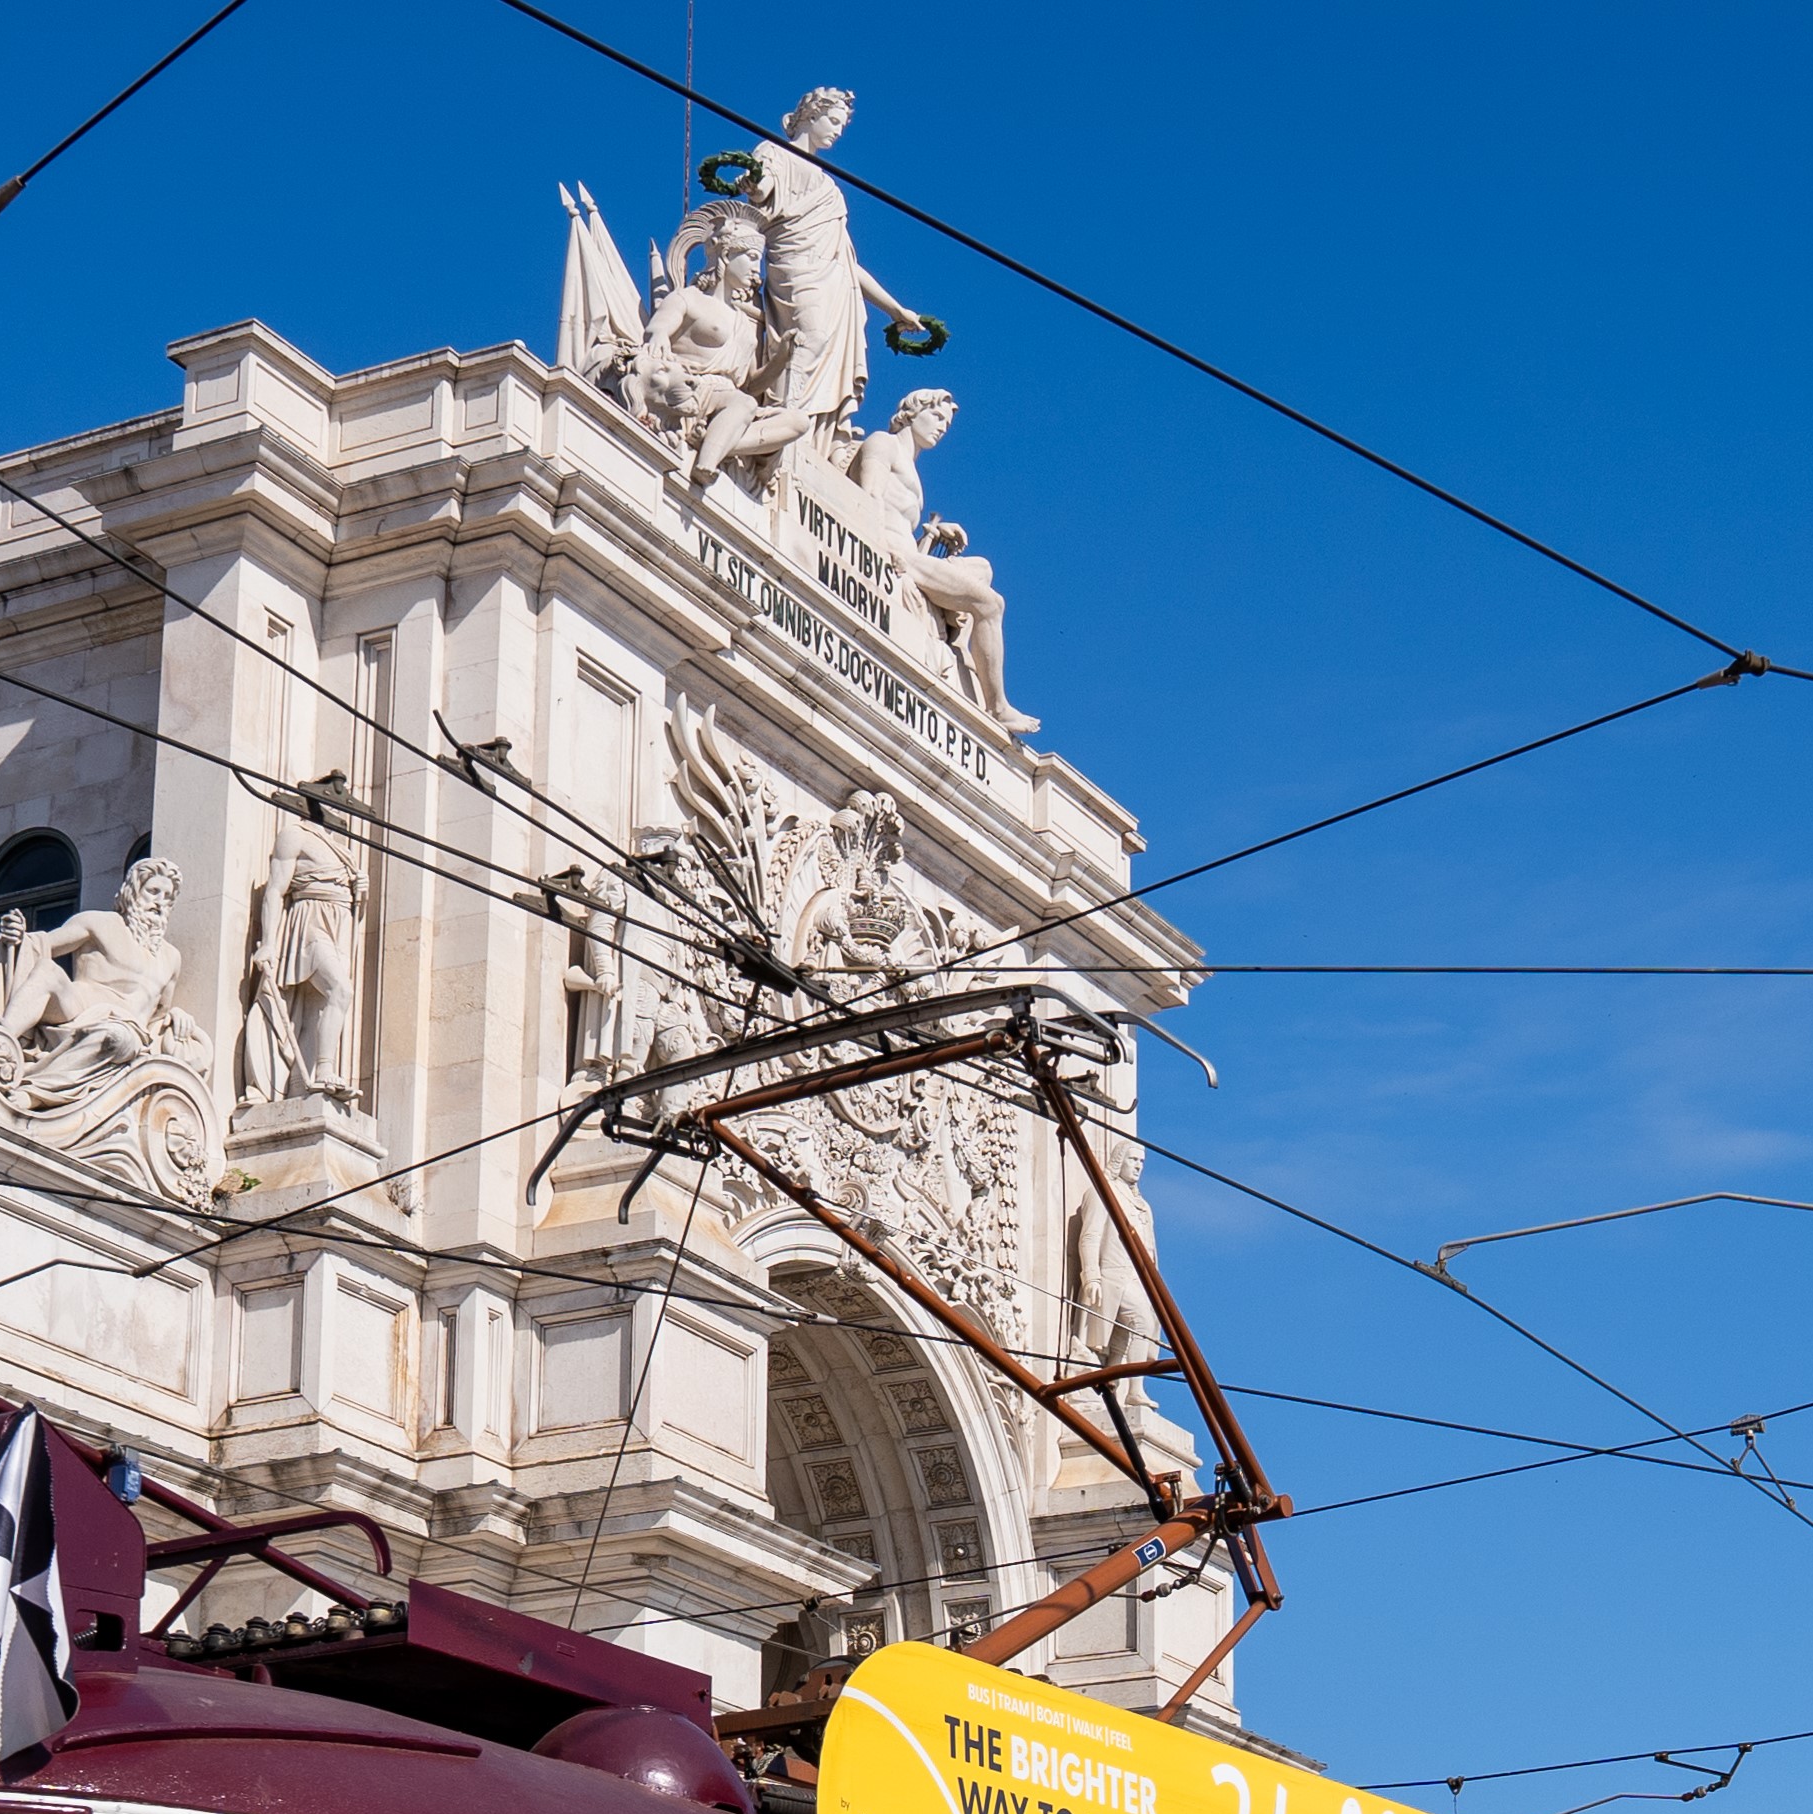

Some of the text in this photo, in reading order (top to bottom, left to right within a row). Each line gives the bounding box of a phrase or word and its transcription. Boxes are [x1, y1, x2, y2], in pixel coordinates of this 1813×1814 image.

[797, 491, 894, 596] VIRTVTIBVS
[818, 551, 891, 635] MAIORVM
[944, 1714, 1002, 1773] THE
[968, 1683, 1133, 1752] BUS TRAM BOAT WALK FEEL
[840, 1797, 850, 1811] by
